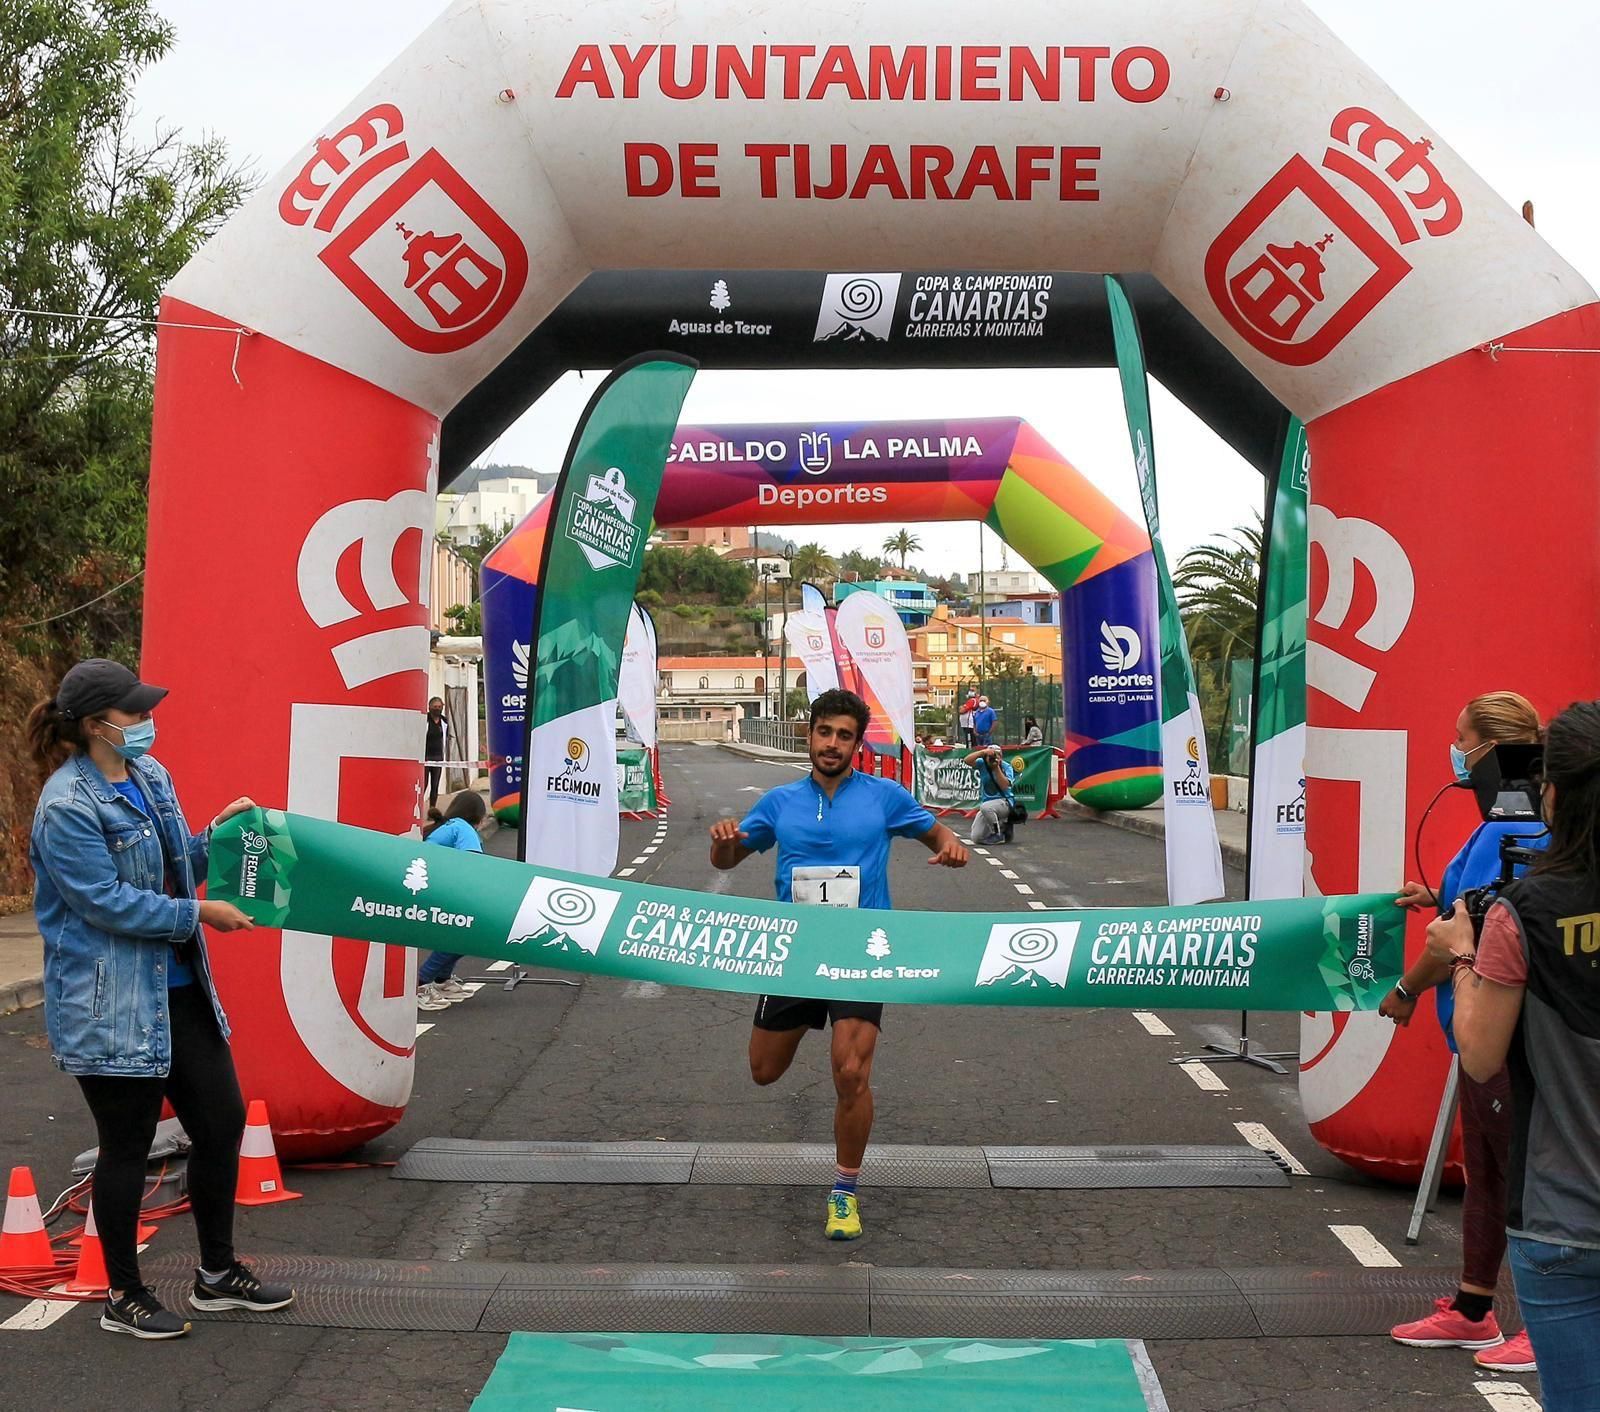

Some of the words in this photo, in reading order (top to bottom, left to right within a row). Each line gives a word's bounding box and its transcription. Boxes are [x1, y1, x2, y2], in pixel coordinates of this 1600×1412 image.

[555, 44, 1171, 104] AYUNTAMIENTO
[623, 142, 721, 198] DE
[744, 143, 1101, 201] TIJARAFE
[916, 277, 949, 291] COPA
[952, 276, 963, 291] &
[965, 275, 1053, 291] CAMPEONATO
[909, 291, 1050, 321] CANARIAS
[668, 319, 712, 335] Aguas
[714, 320, 734, 334] de
[735, 320, 773, 335] Teror
[905, 323, 972, 338] CARRERAS
[973, 322, 983, 337] X
[984, 320, 1044, 337] MONTAÑA
[843, 438, 881, 460] LA
[887, 436, 983, 459] PALMA
[758, 483, 888, 508] Deportes
[573, 509, 633, 553] CANARIAS
[577, 500, 593, 515] COPA
[598, 510, 636, 537] CAMPEONATO
[571, 526, 599, 546] CARRERAS
[1088, 674, 1154, 690] deportes
[1089, 695, 1117, 703] CABILDO
[547, 776, 601, 797] FECAMON
[245, 855, 259, 898] FECAMON
[819, 881, 829, 903] 1
[350, 896, 402, 918] Aguas
[405, 904, 428, 922] de
[429, 907, 474, 928] Teror
[636, 900, 676, 920] COPA
[679, 906, 692, 923] &
[694, 908, 799, 935] CAMPEONATO
[625, 914, 792, 962] CANARIAS
[1098, 921, 1138, 936] COPA
[1141, 920, 1154, 934] &
[1157, 915, 1262, 933] CAMPEONATO
[1356, 913, 1368, 956] FECAMON
[618, 939, 698, 966] CARRERAS
[699, 954, 711, 968] X
[712, 956, 783, 977] MONTAÑA
[1091, 933, 1258, 967] CANARIAS
[815, 963, 868, 980] Aguas
[870, 966, 893, 979] de
[895, 966, 940, 979] Teror
[1086, 967, 1165, 986] CARRERAS
[1167, 968, 1179, 986] X
[1180, 966, 1250, 987] MONTAÑA
